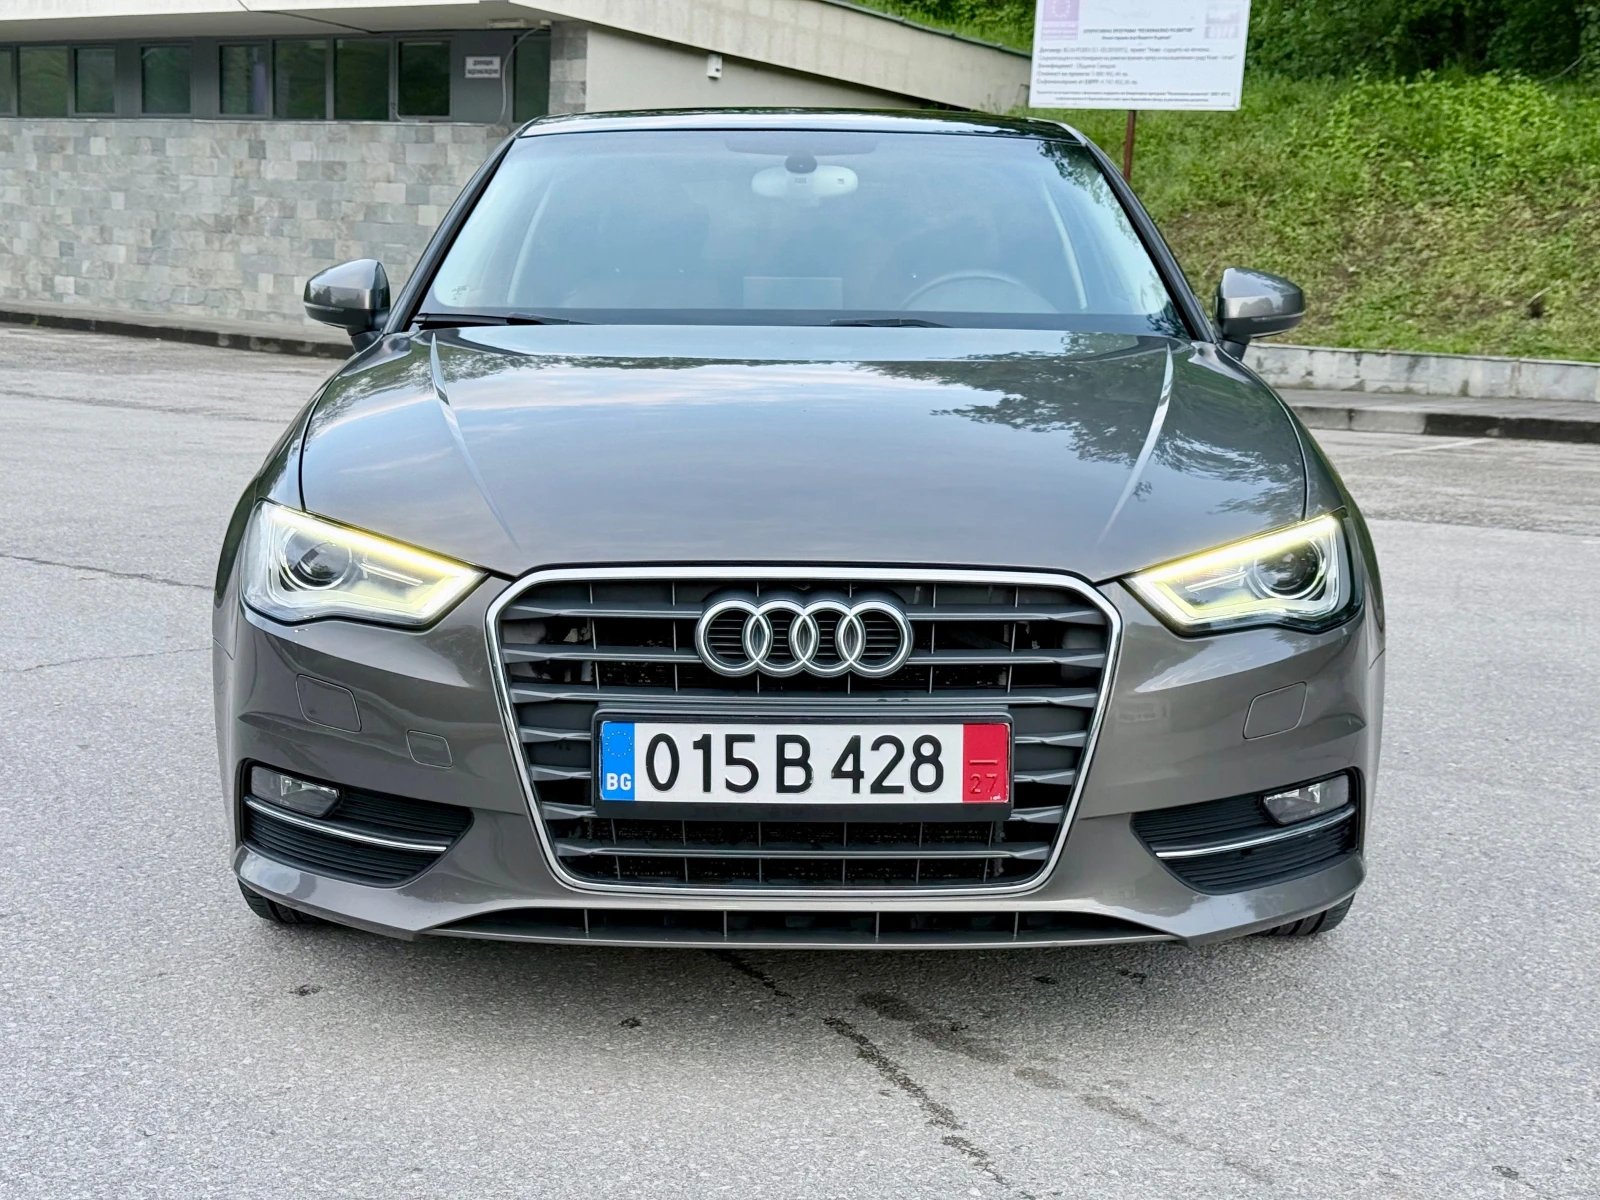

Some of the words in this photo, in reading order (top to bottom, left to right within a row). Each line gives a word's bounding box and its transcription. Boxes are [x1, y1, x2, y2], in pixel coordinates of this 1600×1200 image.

[645, 732, 760, 794] 015
[776, 734, 814, 794] B
[831, 734, 944, 794] 428
[606, 772, 632, 791] BG
[969, 773, 998, 794] 27
